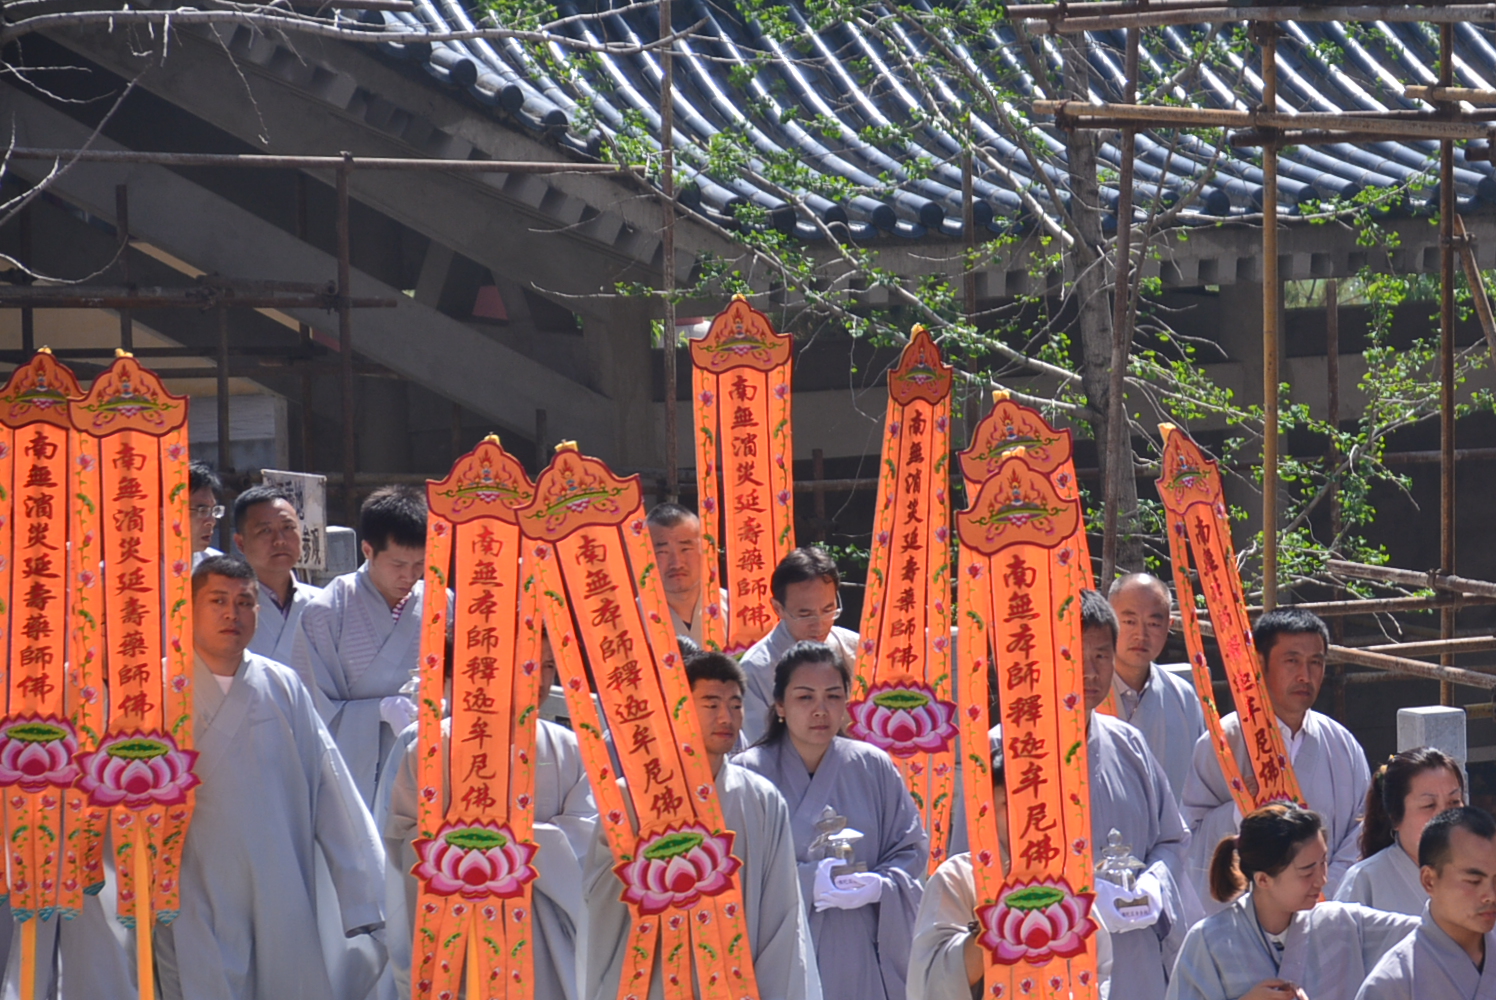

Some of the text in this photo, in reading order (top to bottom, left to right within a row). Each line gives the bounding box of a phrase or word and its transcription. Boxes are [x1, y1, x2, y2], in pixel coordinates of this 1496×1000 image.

[17, 431, 61, 704] 南無消災延壽藥師佛
[111, 443, 155, 720] 南無消災延壽藥師佛
[728, 374, 771, 633] 南無消災延壽藥師佛
[886, 409, 927, 672] 南無消災延壽藥師佛
